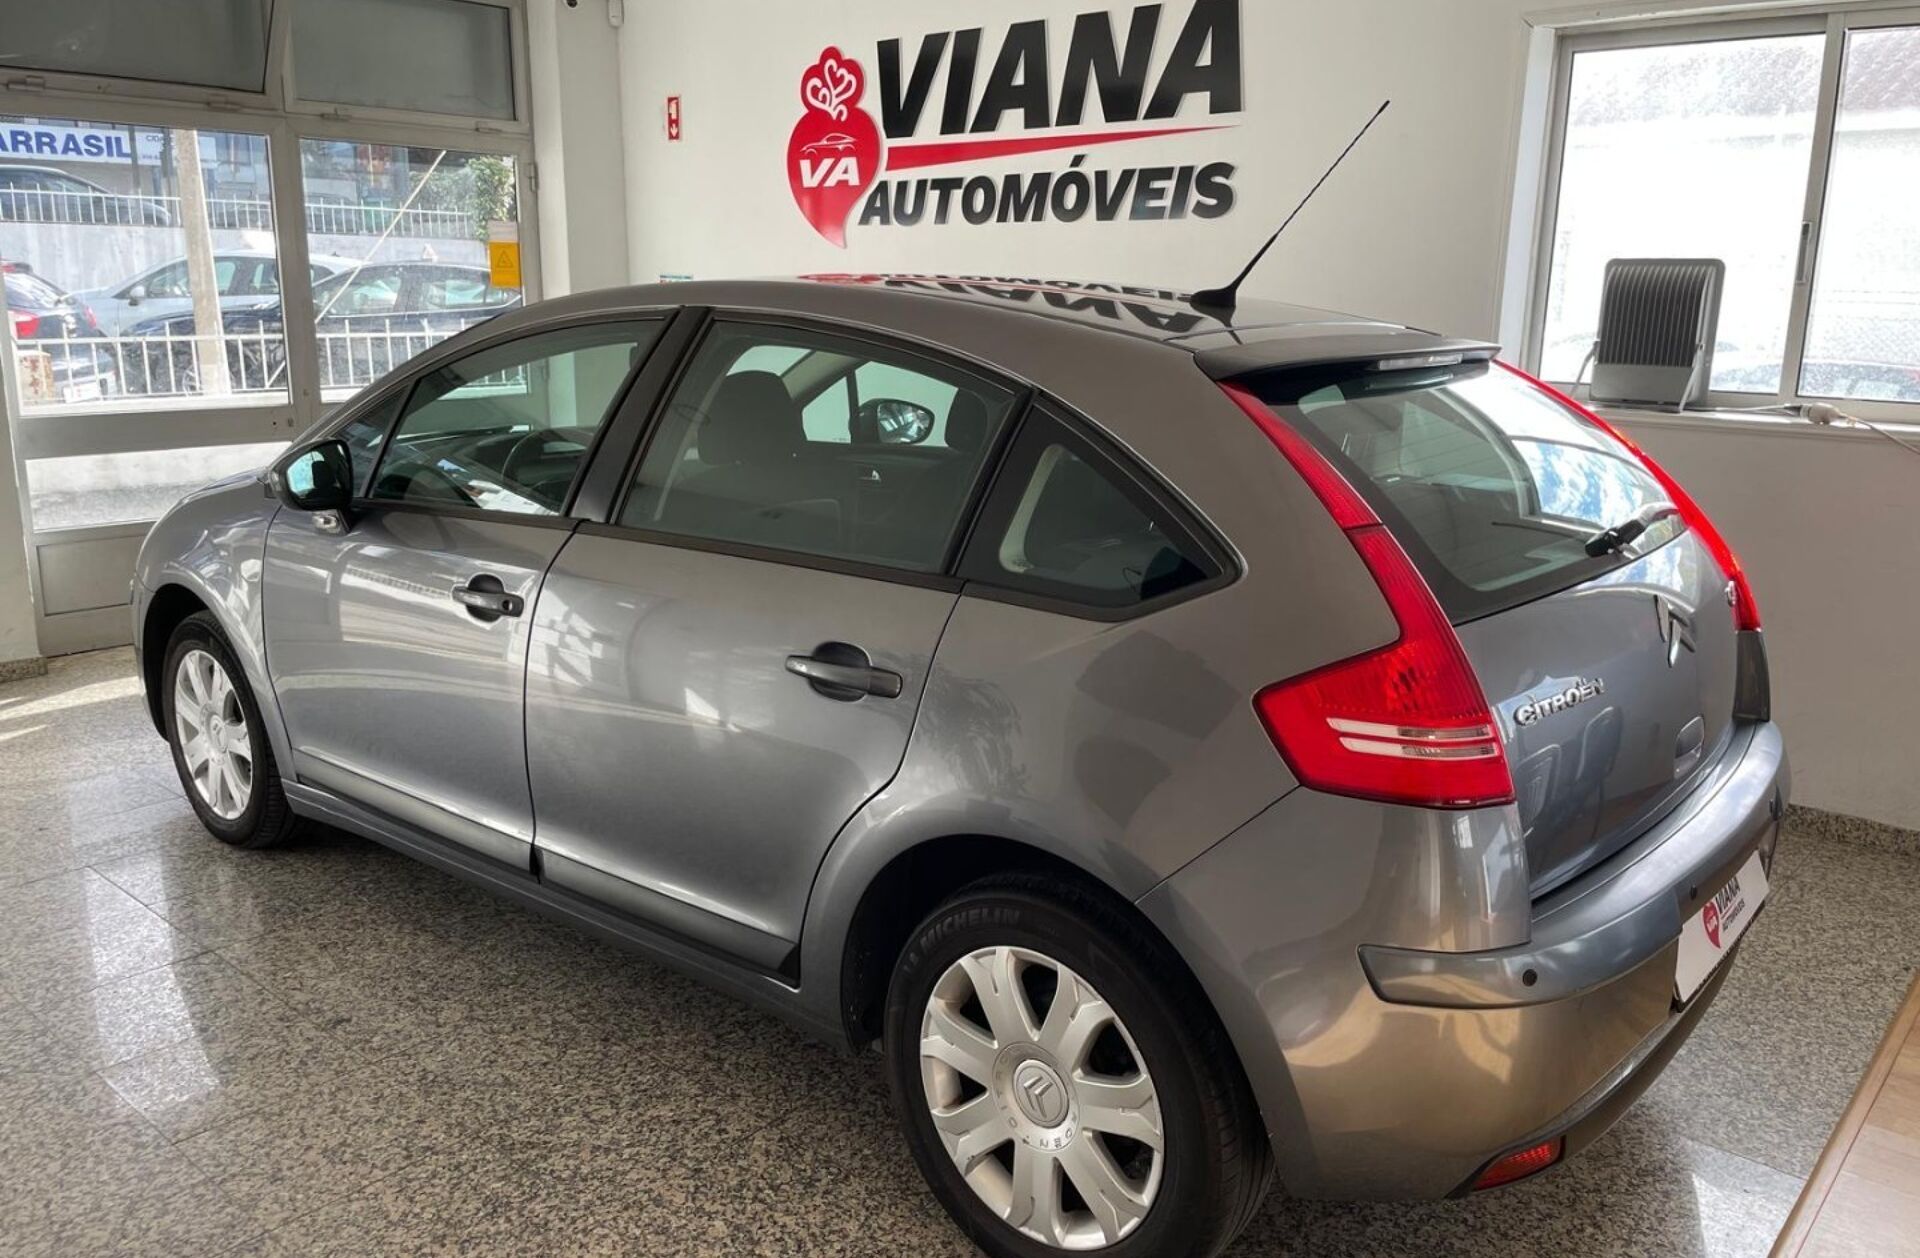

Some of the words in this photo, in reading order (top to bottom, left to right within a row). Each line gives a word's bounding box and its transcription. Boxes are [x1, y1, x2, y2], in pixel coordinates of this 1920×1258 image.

[876, 0, 1243, 138] VIANA
[798, 156, 861, 188] VA
[858, 154, 1238, 227] AUTOMÓVEIS
[1514, 677, 1605, 727] CITROËN
[919, 907, 1021, 955] MICHELIN
